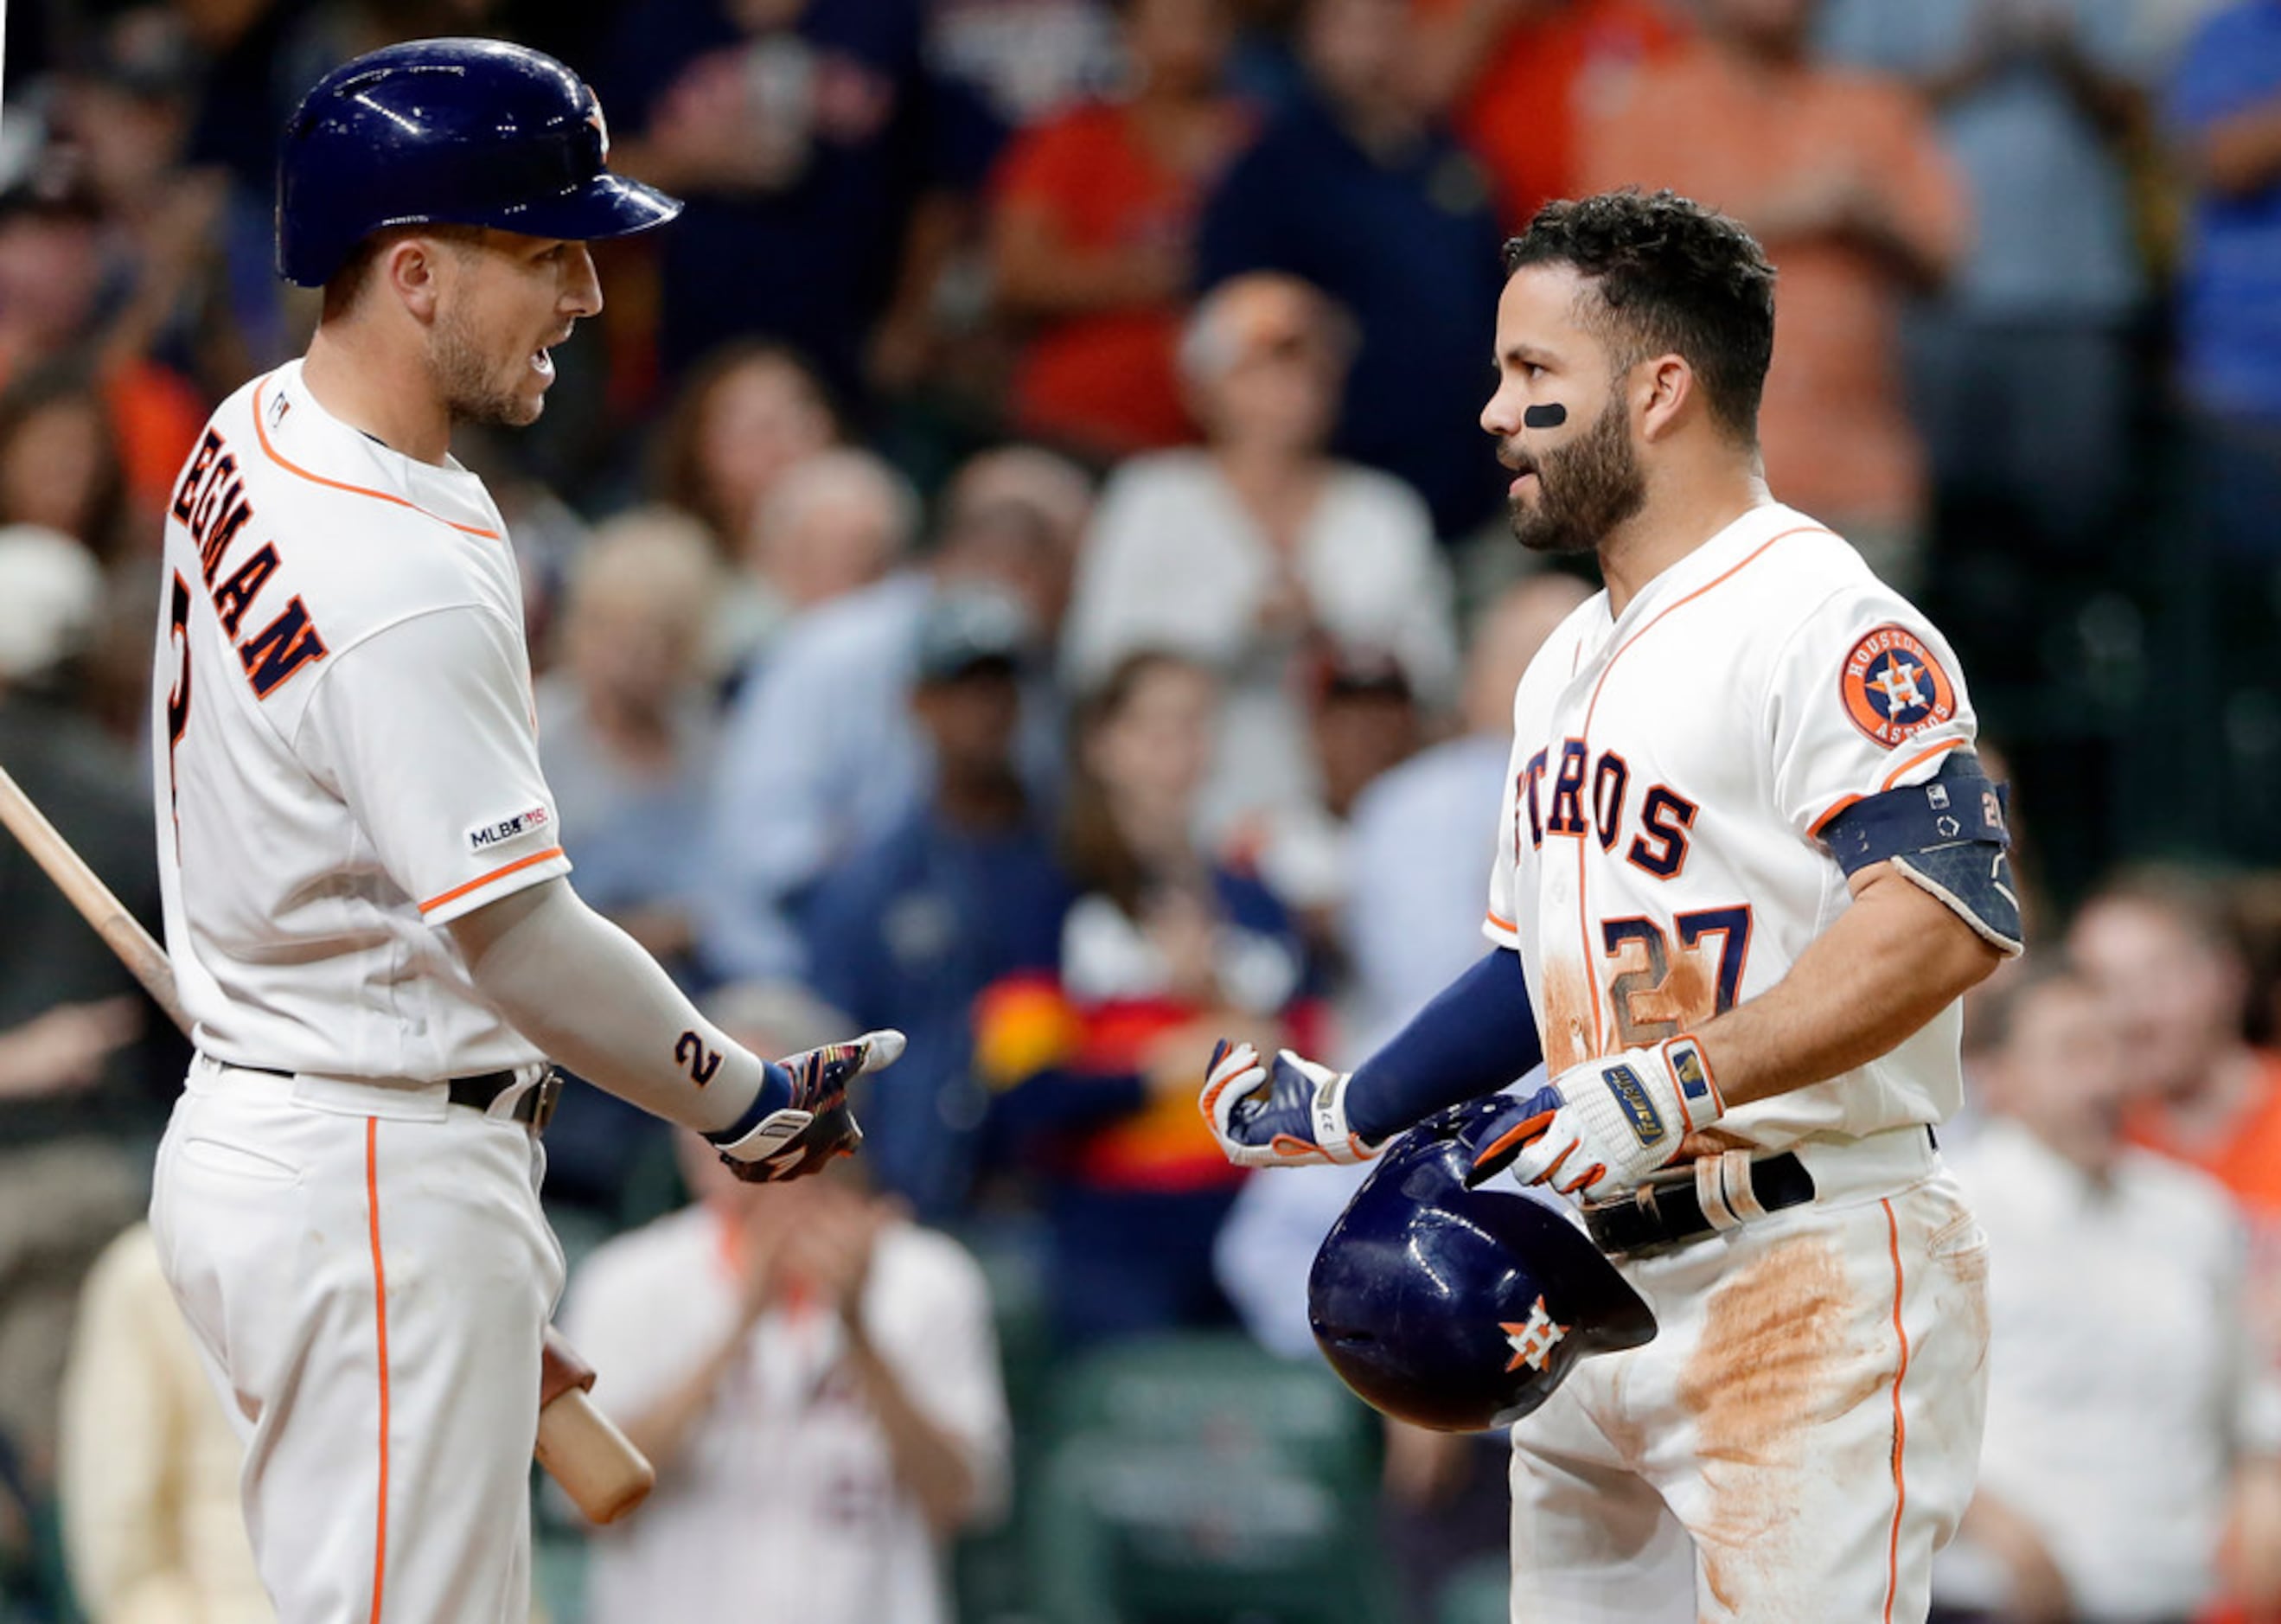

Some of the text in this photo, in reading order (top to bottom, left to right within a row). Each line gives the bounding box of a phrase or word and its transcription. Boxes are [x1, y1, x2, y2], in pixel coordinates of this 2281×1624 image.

[1848, 632, 1926, 678] HOUSTON
[470, 821, 513, 847] MLB
[1600, 903, 1753, 1051] 27
[674, 1029, 723, 1088] 2
